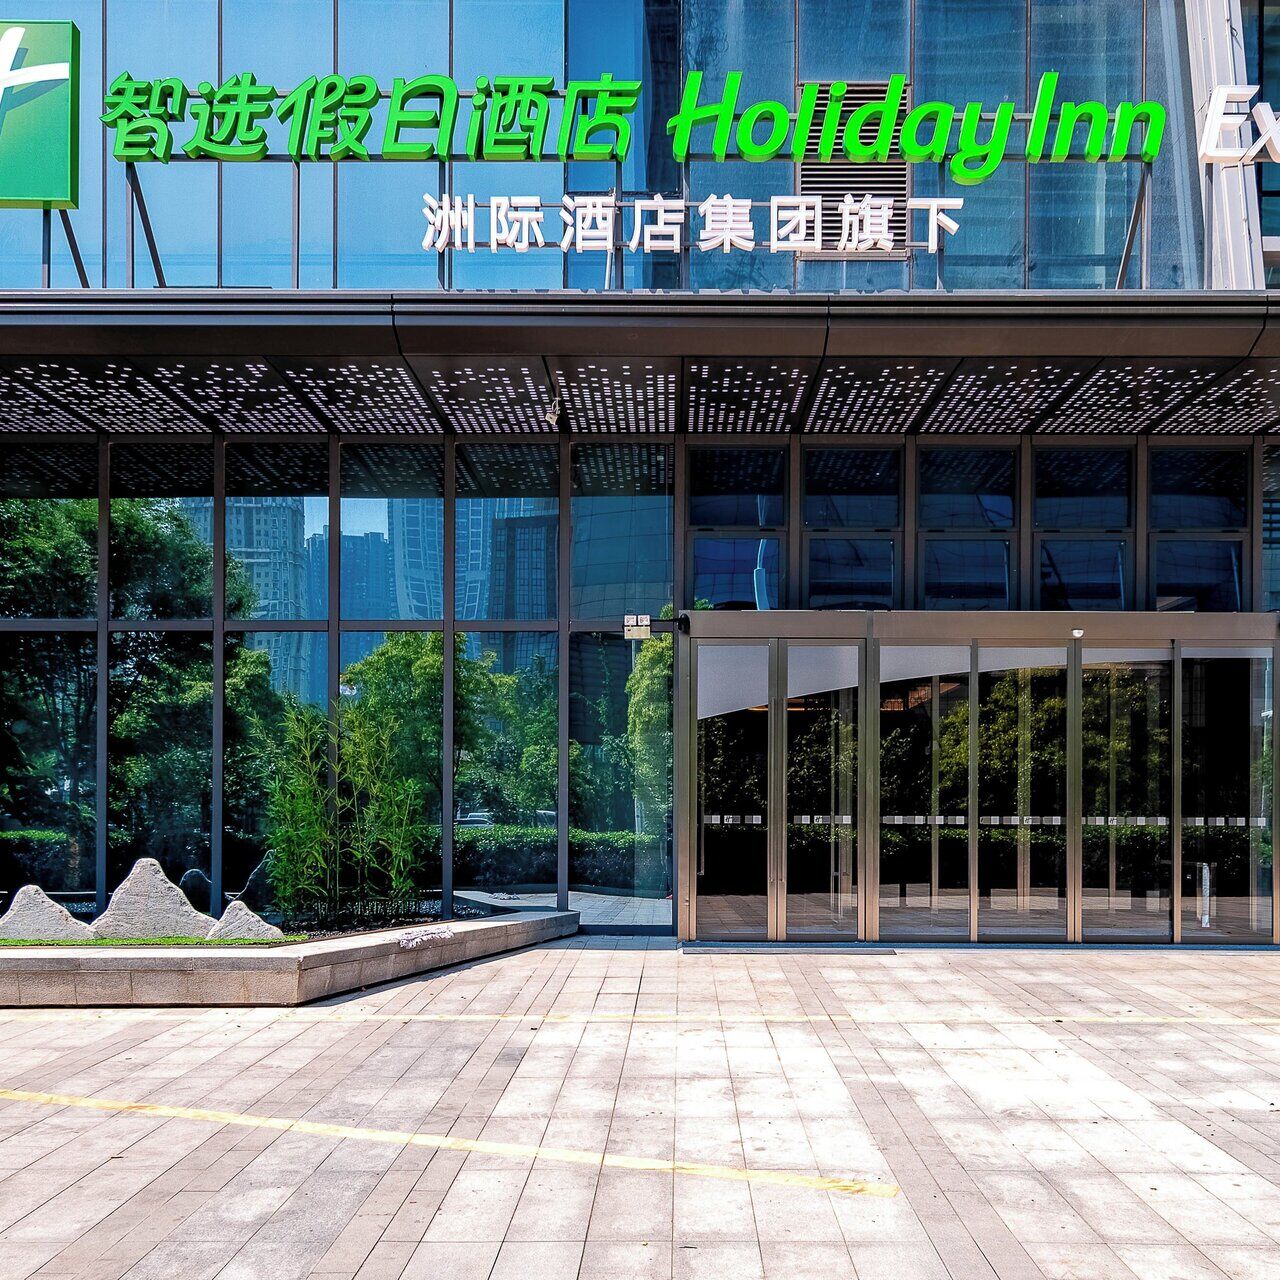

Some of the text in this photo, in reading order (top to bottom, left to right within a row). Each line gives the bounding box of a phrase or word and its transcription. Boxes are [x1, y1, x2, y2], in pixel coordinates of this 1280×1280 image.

[99, 71, 643, 164] 智选假日酒店
[666, 70, 1015, 185] Holiday
[1023, 70, 1167, 164] Inn
[421, 192, 965, 255] 洲际酒店集团旗下
